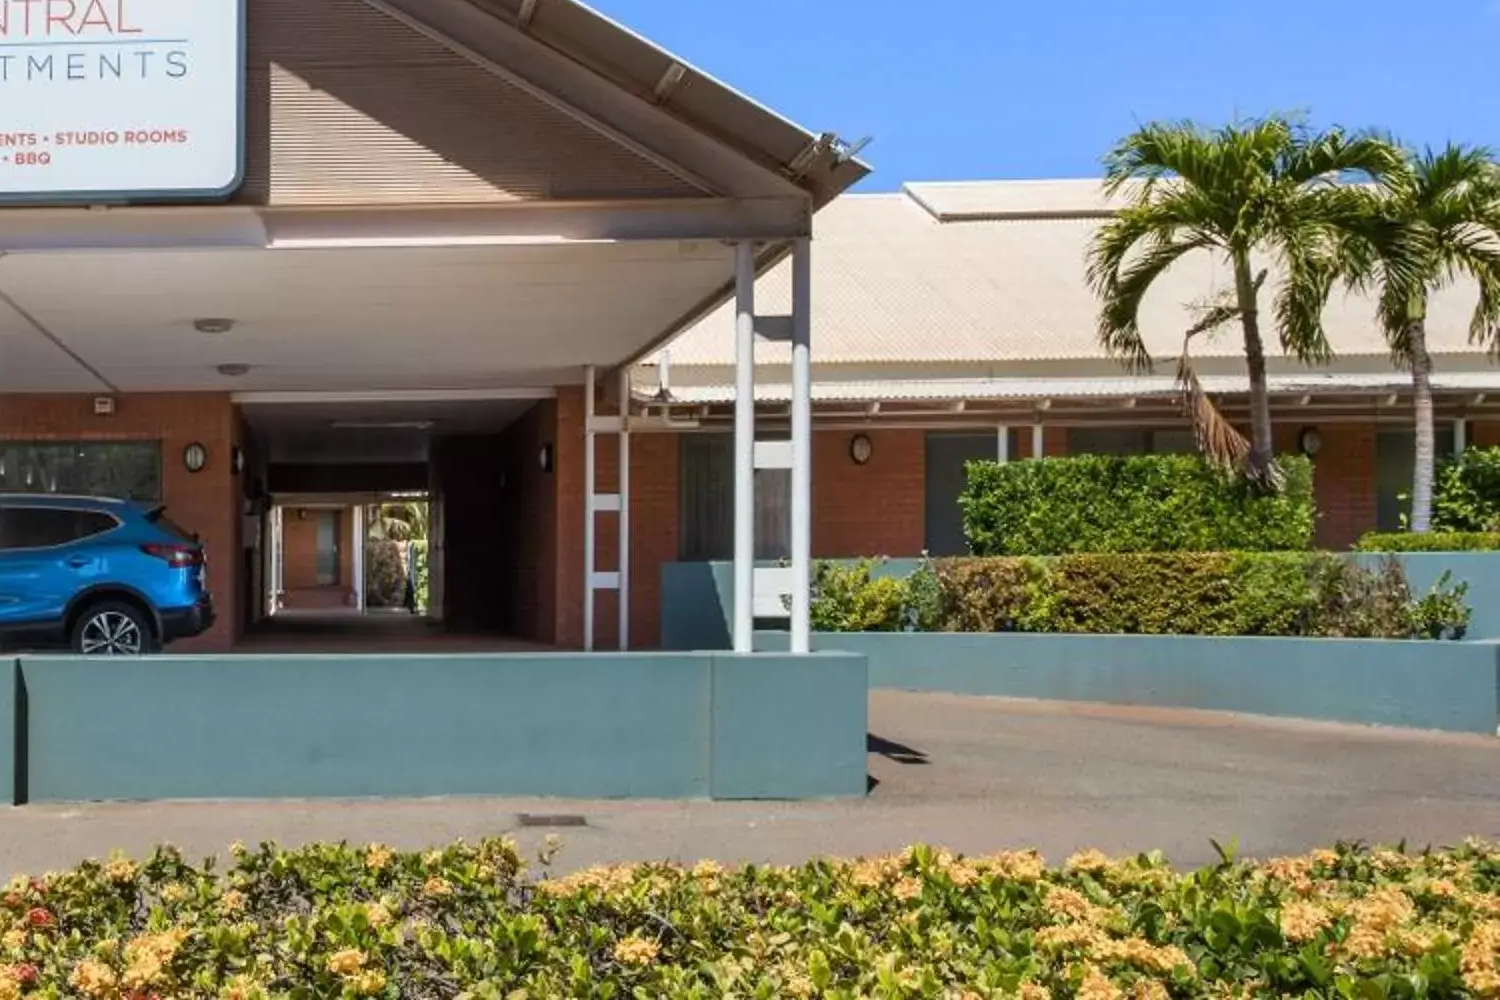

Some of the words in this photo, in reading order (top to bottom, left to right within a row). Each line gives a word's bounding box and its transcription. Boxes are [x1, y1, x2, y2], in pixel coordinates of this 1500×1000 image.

[55, 131, 119, 145] STUDIO
[124, 129, 188, 143] ROOMS
[15, 151, 51, 166] BBQ
